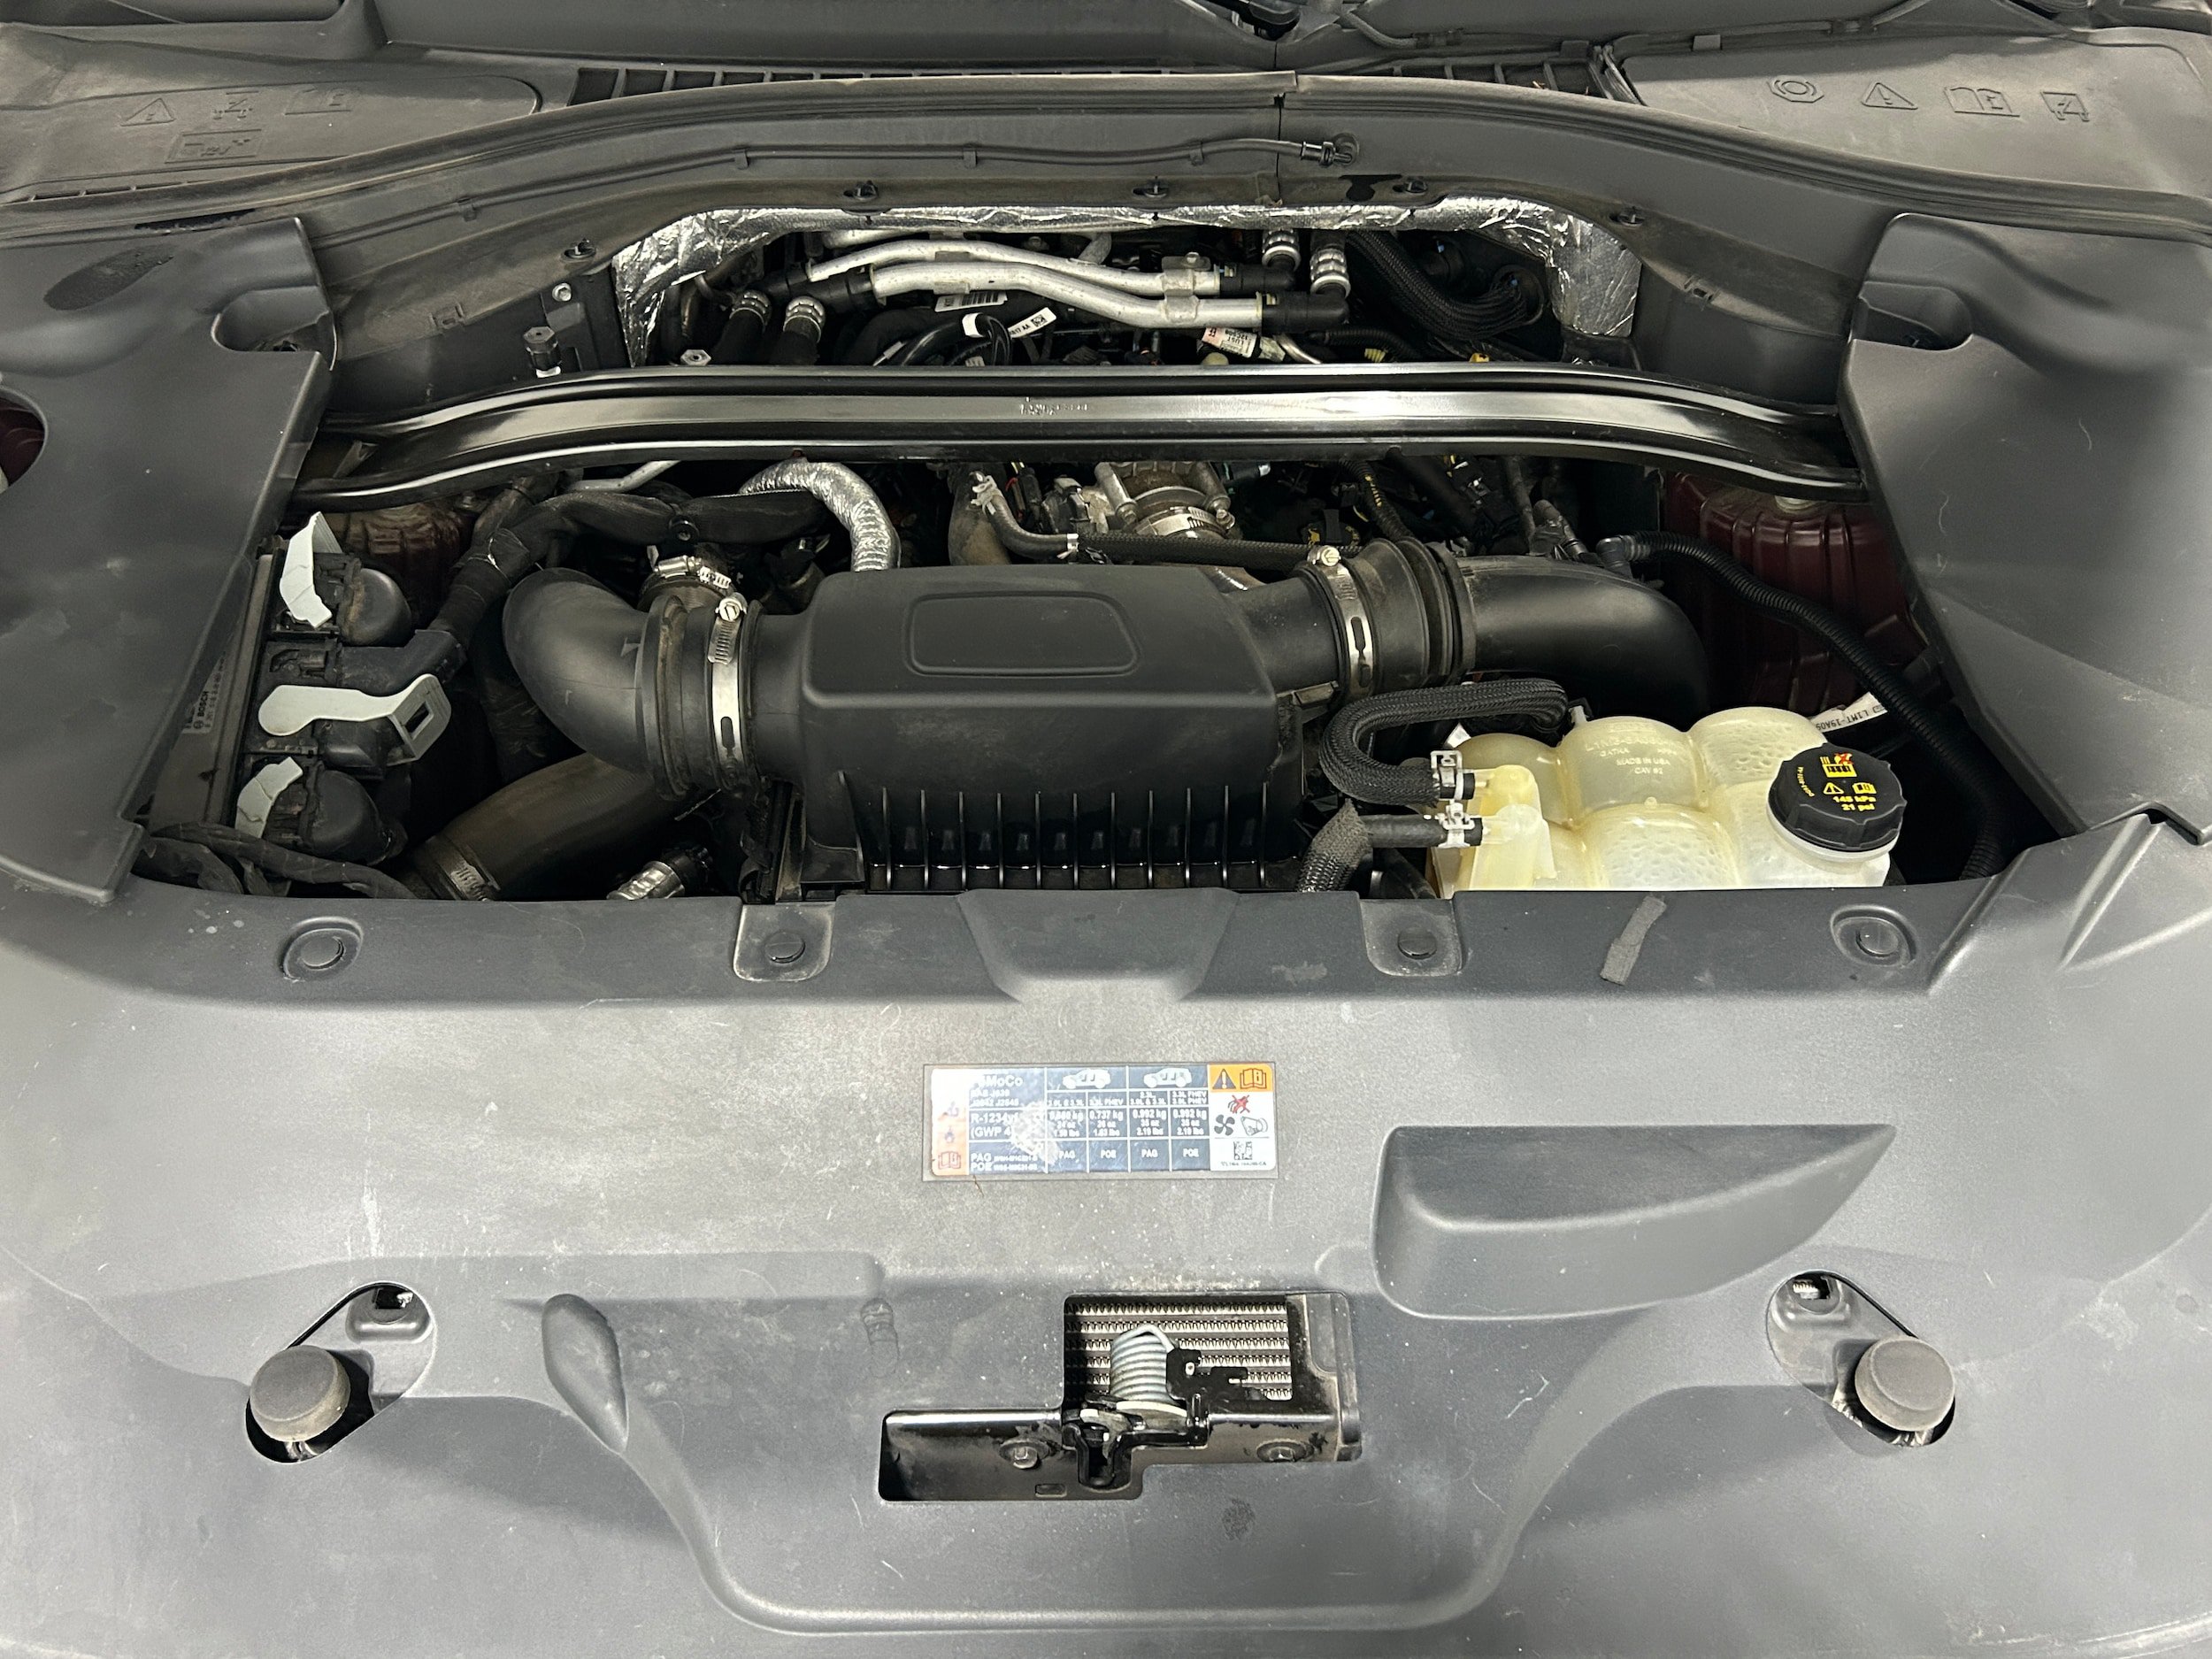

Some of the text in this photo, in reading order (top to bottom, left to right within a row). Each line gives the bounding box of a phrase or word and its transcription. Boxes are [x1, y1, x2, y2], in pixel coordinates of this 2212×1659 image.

[197, 691, 209, 717] BOSCH
[1617, 757, 1641, 766] MADE
[1072, 1110, 1084, 1122] kg
[1089, 1110, 1124, 1122] 0.737 kg
[1133, 1109, 1166, 1120] 0.992 kg
[1195, 1109, 1207, 1120] kg
[971, 1125, 1002, 1138] (GWP
[971, 1153, 992, 1162] PAG
[1059, 1150, 1076, 1159] PAG
[1100, 1149, 1117, 1159] POE
[1141, 1148, 1158, 1158] PAG
[1182, 1148, 1199, 1157] POE
[971, 1162, 992, 1172] POE
